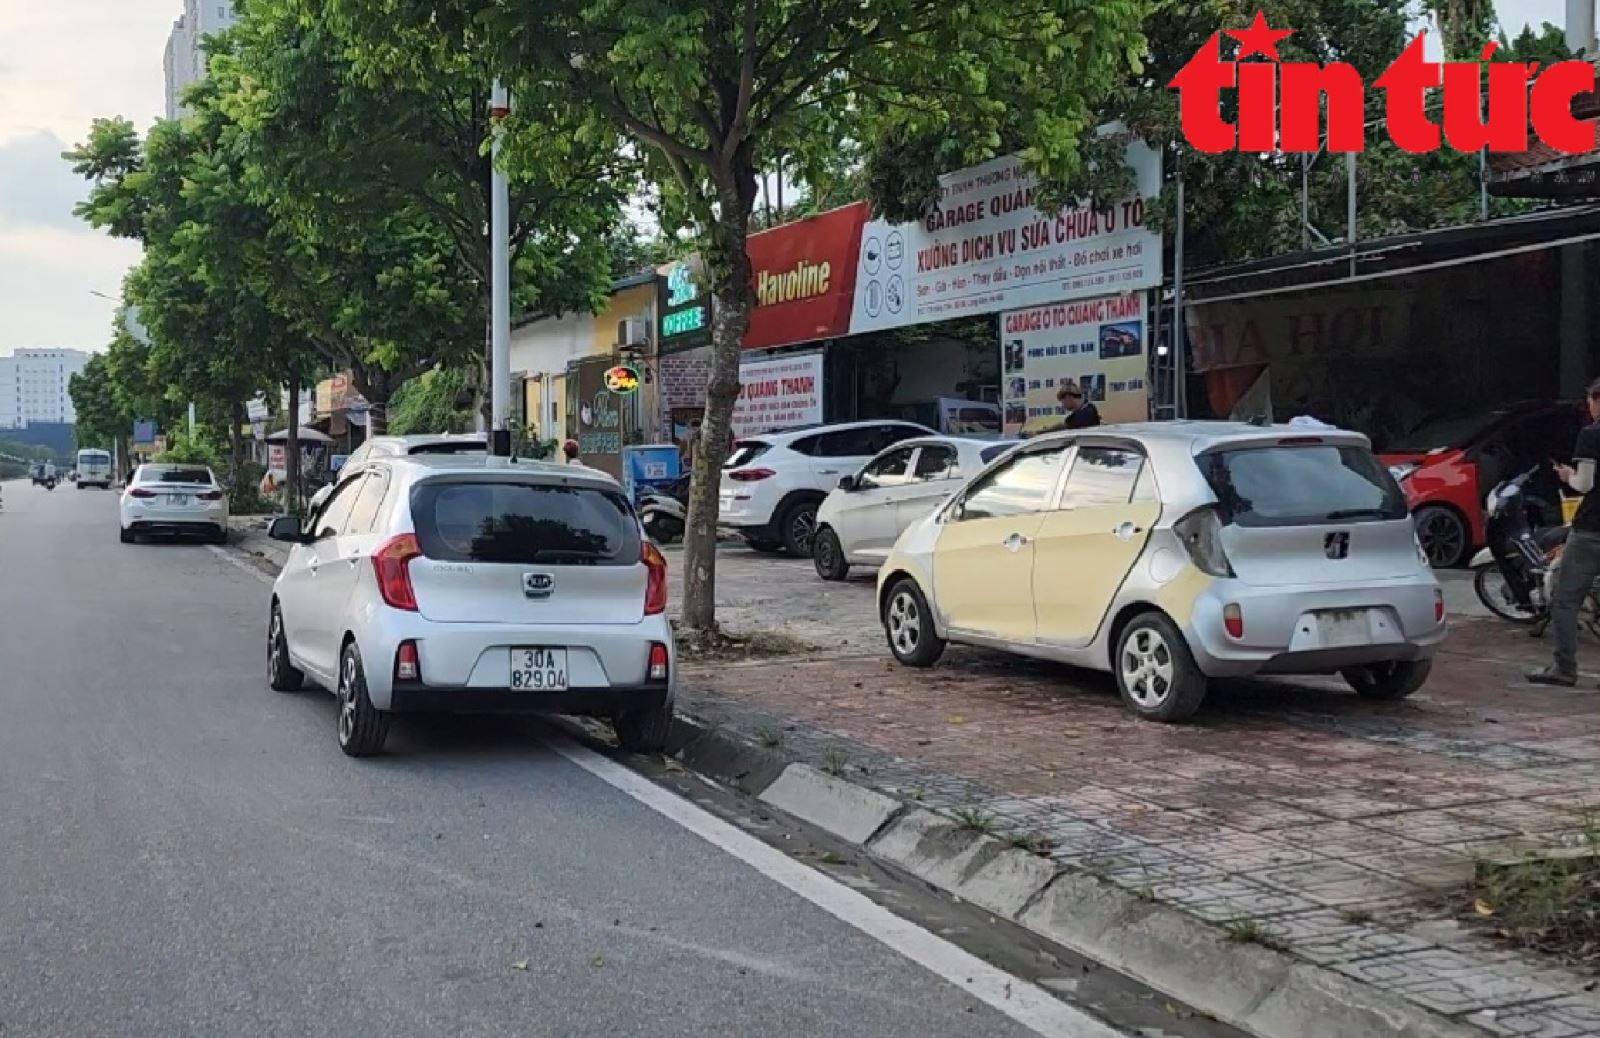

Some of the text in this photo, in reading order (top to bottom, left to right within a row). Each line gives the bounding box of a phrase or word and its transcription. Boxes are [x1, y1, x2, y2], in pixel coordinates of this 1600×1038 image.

[926, 201, 985, 234] GARAGE
[757, 259, 831, 307] Havoline
[524, 650, 555, 669] 30A
[512, 669, 565, 688] 829.04
